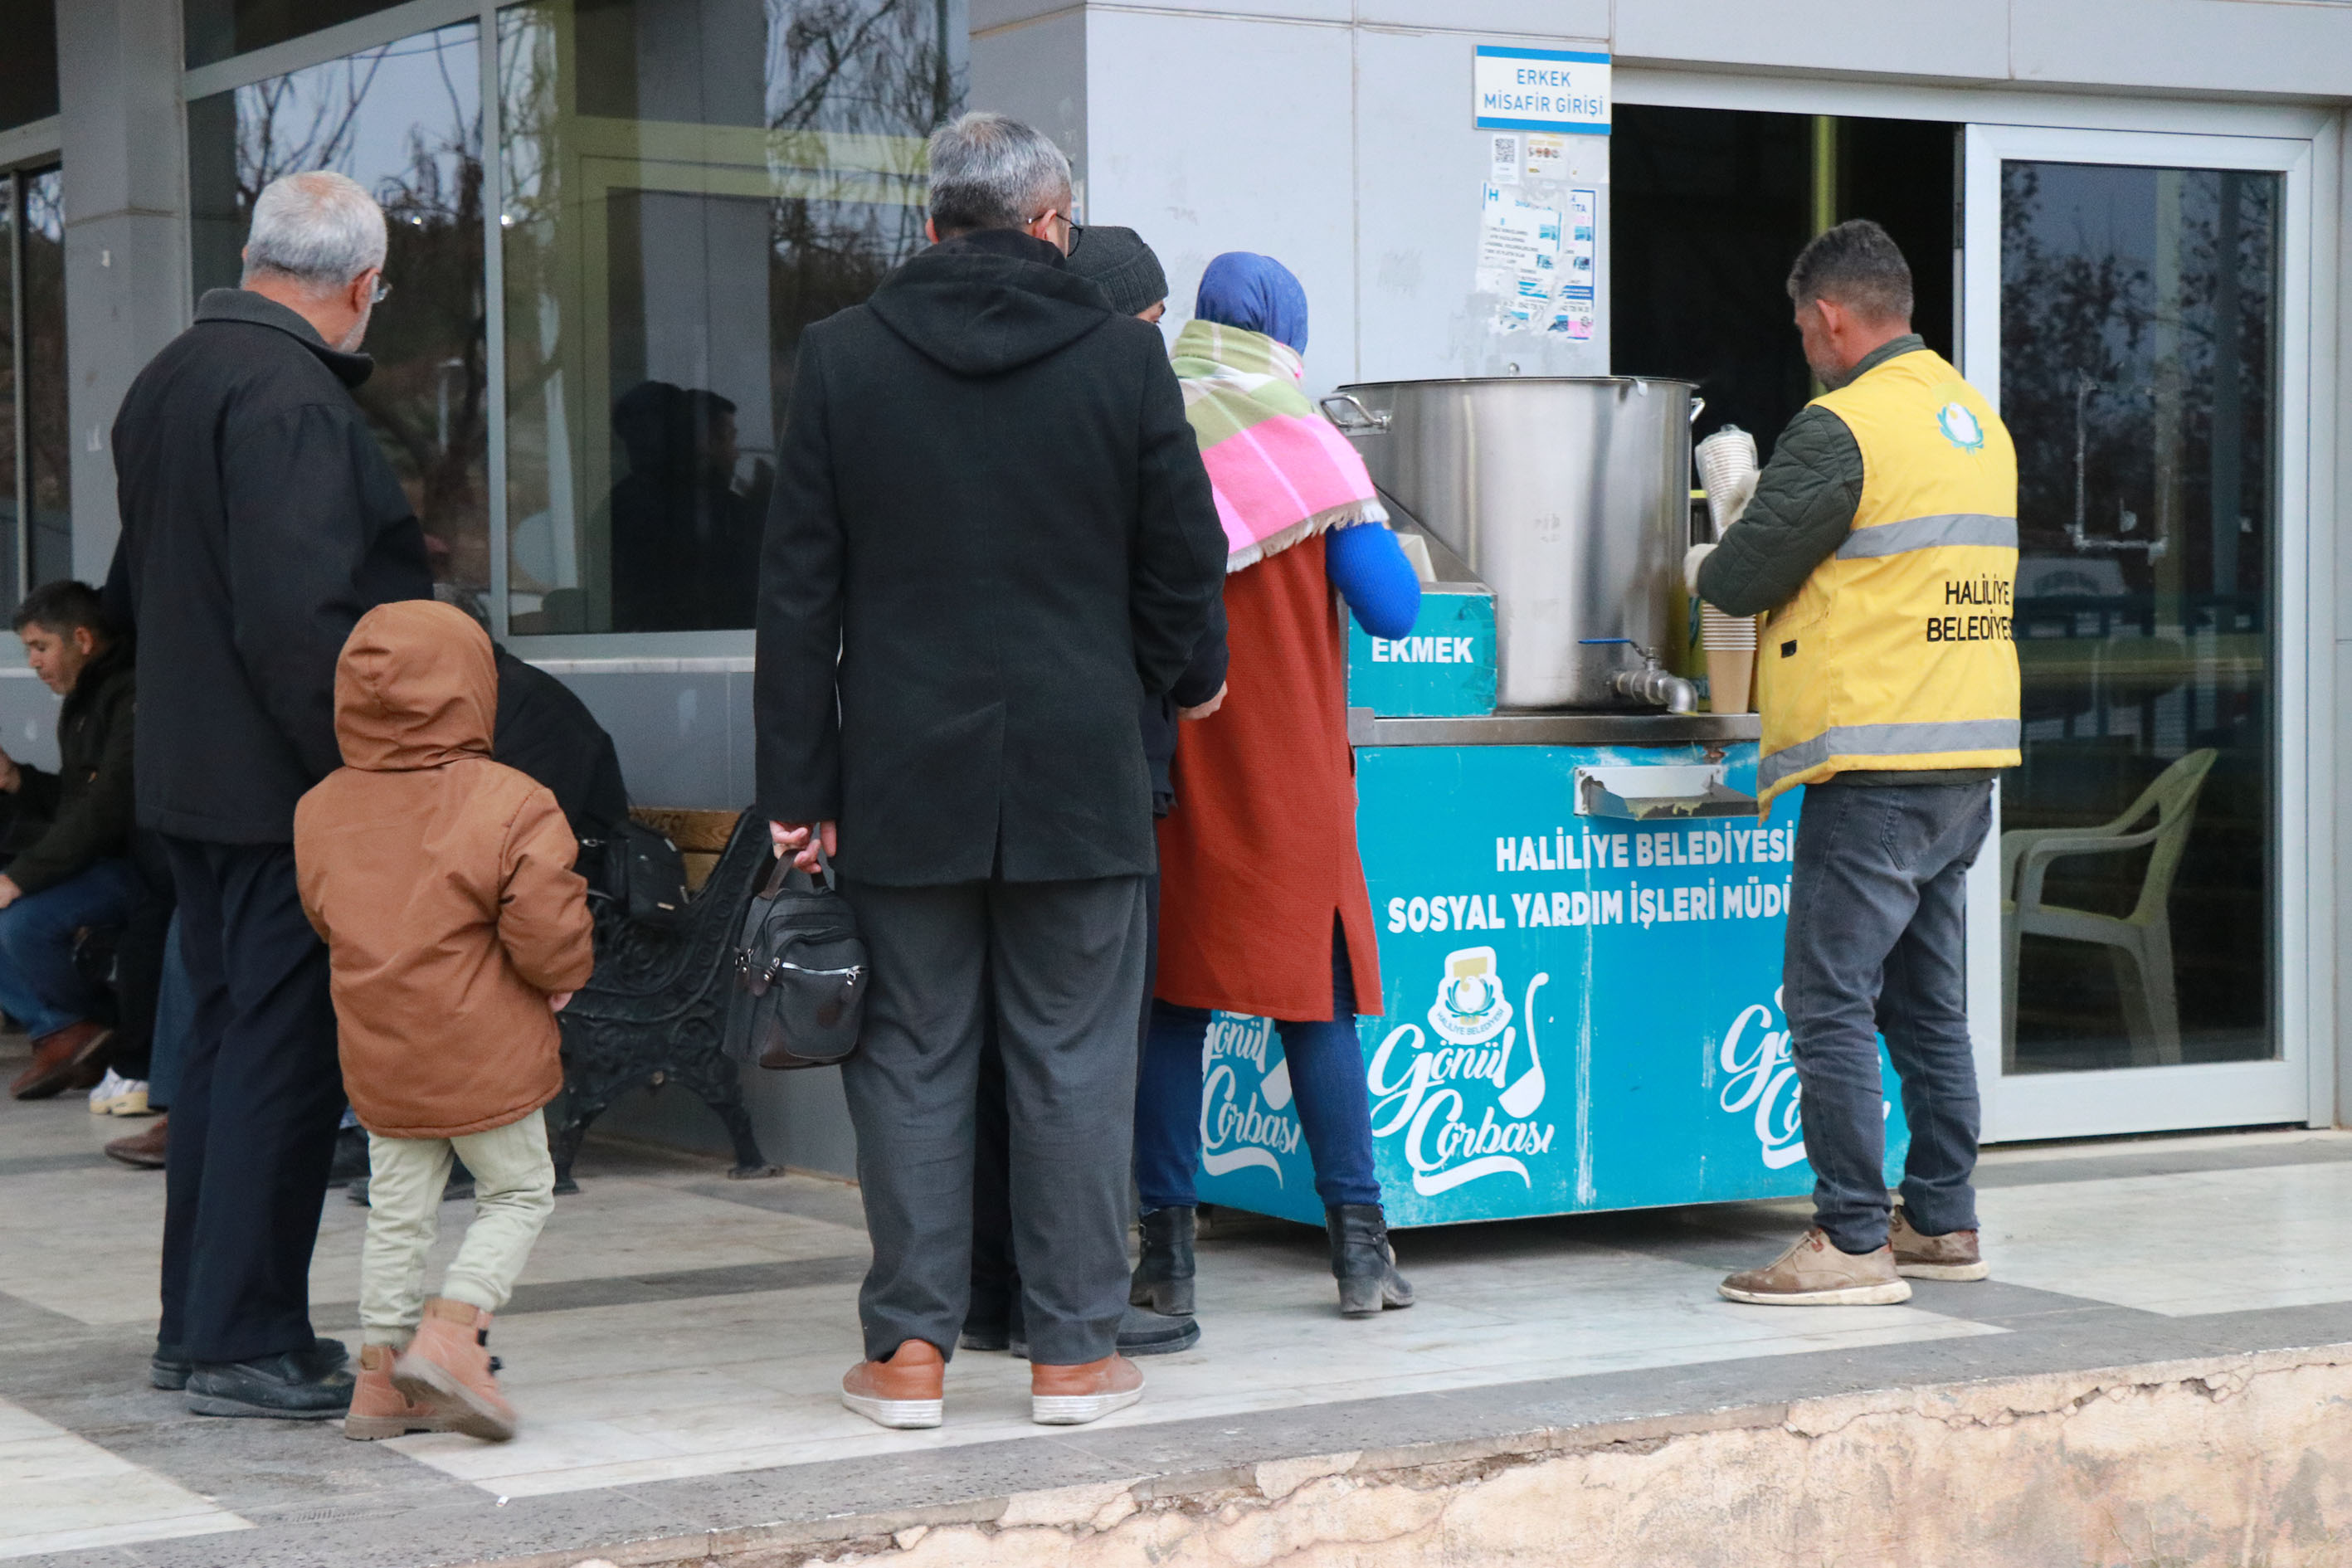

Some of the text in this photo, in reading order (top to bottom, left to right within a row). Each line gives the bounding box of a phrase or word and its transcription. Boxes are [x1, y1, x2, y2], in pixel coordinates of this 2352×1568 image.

[1516, 68, 1571, 87] ERKEK
[1483, 89, 1604, 117] MİSAFİR GİRİŞİ
[1945, 572, 2009, 606] HALİLİYE
[1371, 635, 1474, 664] EKMEK
[1496, 820, 1794, 872] HALİLİYE BELEDİYESİ
[1387, 894, 1506, 934] SOSYAL
[1511, 889, 1623, 928] YARDIM
[1630, 877, 1716, 930] İŞLERİ
